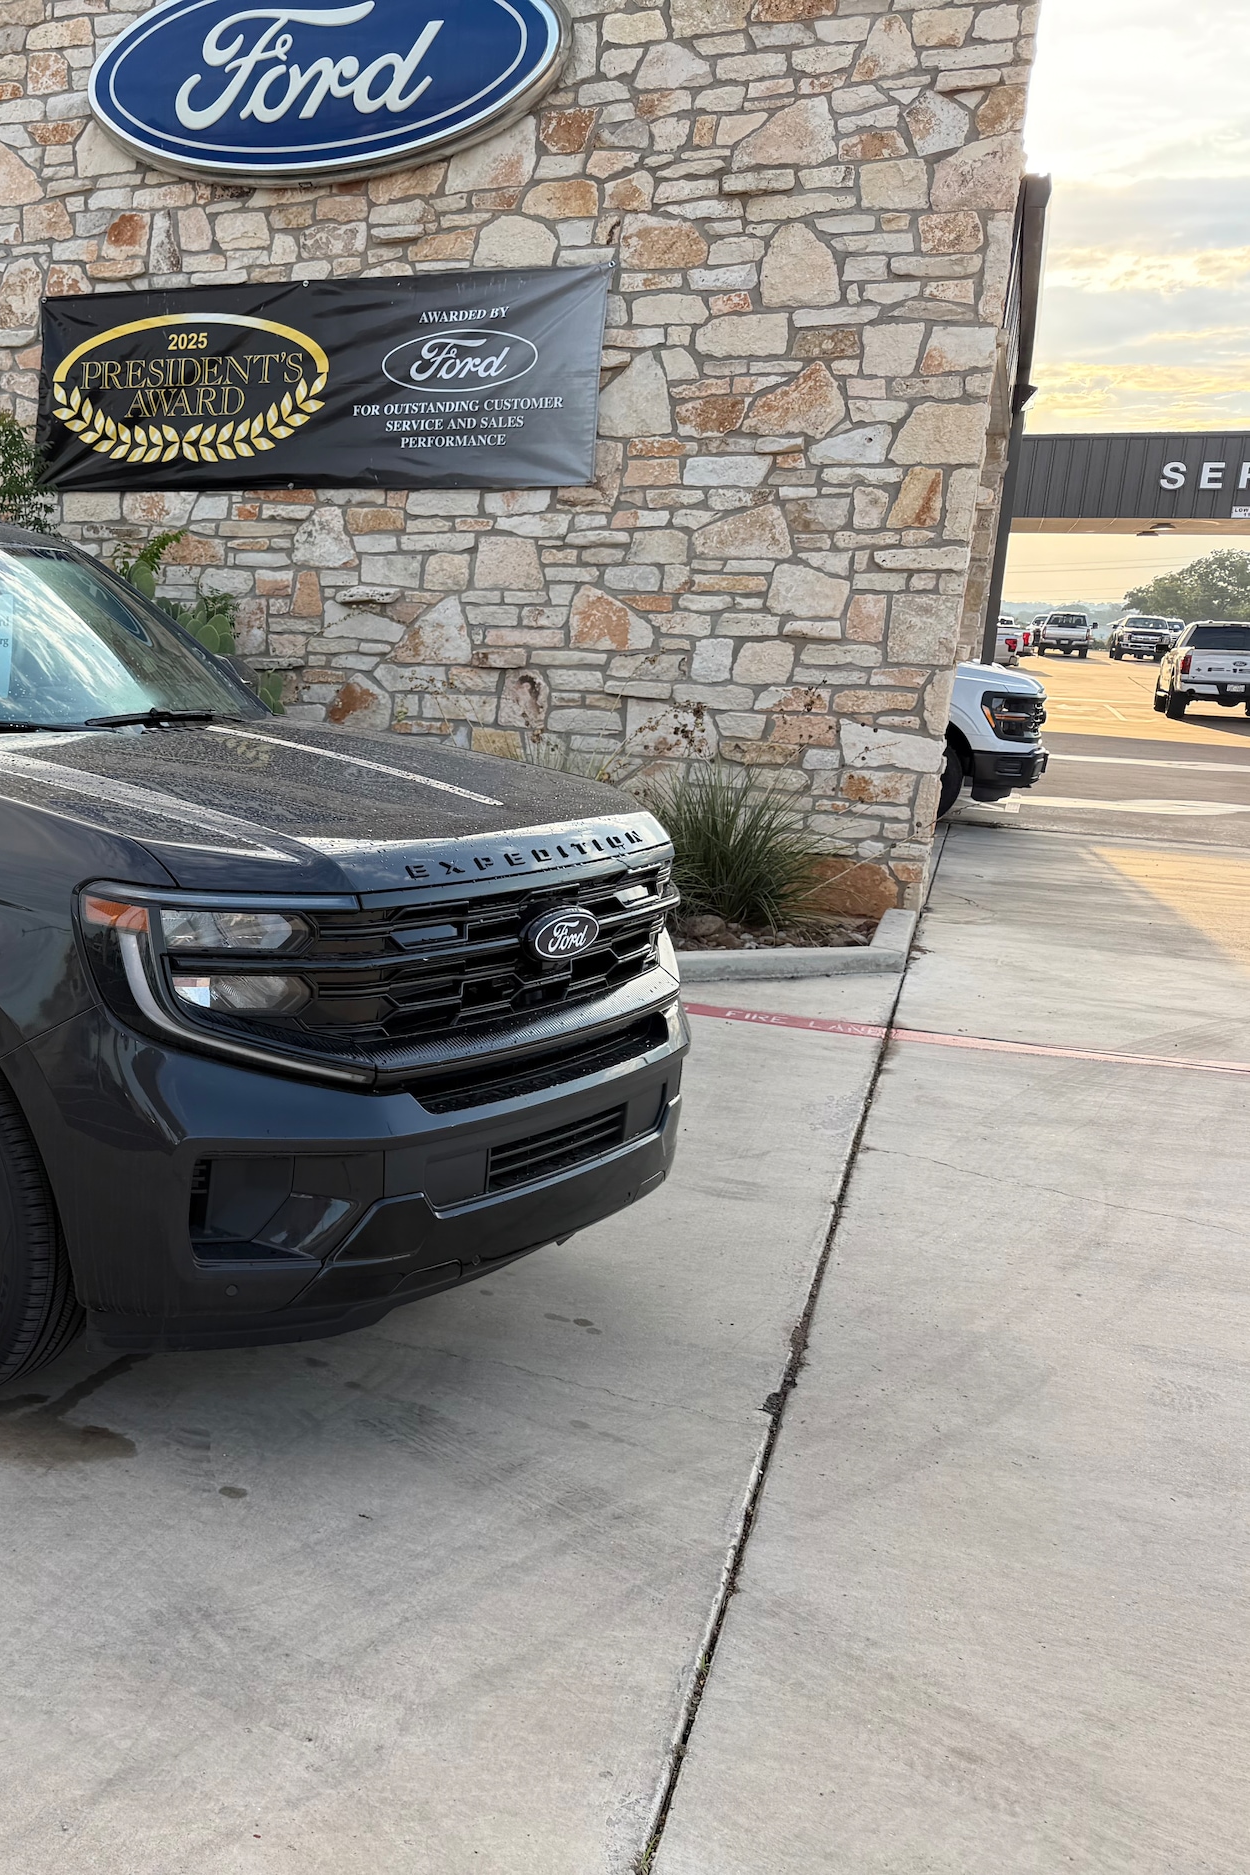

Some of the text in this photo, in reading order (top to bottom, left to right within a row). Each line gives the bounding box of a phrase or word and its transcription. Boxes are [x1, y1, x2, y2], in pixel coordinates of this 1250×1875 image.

[176, 1, 444, 130] Ford
[419, 306, 510, 324] AWARDED BY
[167, 333, 208, 350] 2025
[80, 352, 304, 390] PRESIDENT'S
[410, 338, 510, 381] Ford
[124, 386, 245, 418] AWARD
[352, 396, 564, 417] FOR OUTSTANDING CUSTOMER
[385, 415, 525, 432] SERVICE AND SALES
[400, 434, 507, 449] PERFORMANCE
[404, 830, 644, 880] EXPEDITION
[548, 920, 589, 952] Ford
[725, 1010, 880, 1037] FIRE LANE
